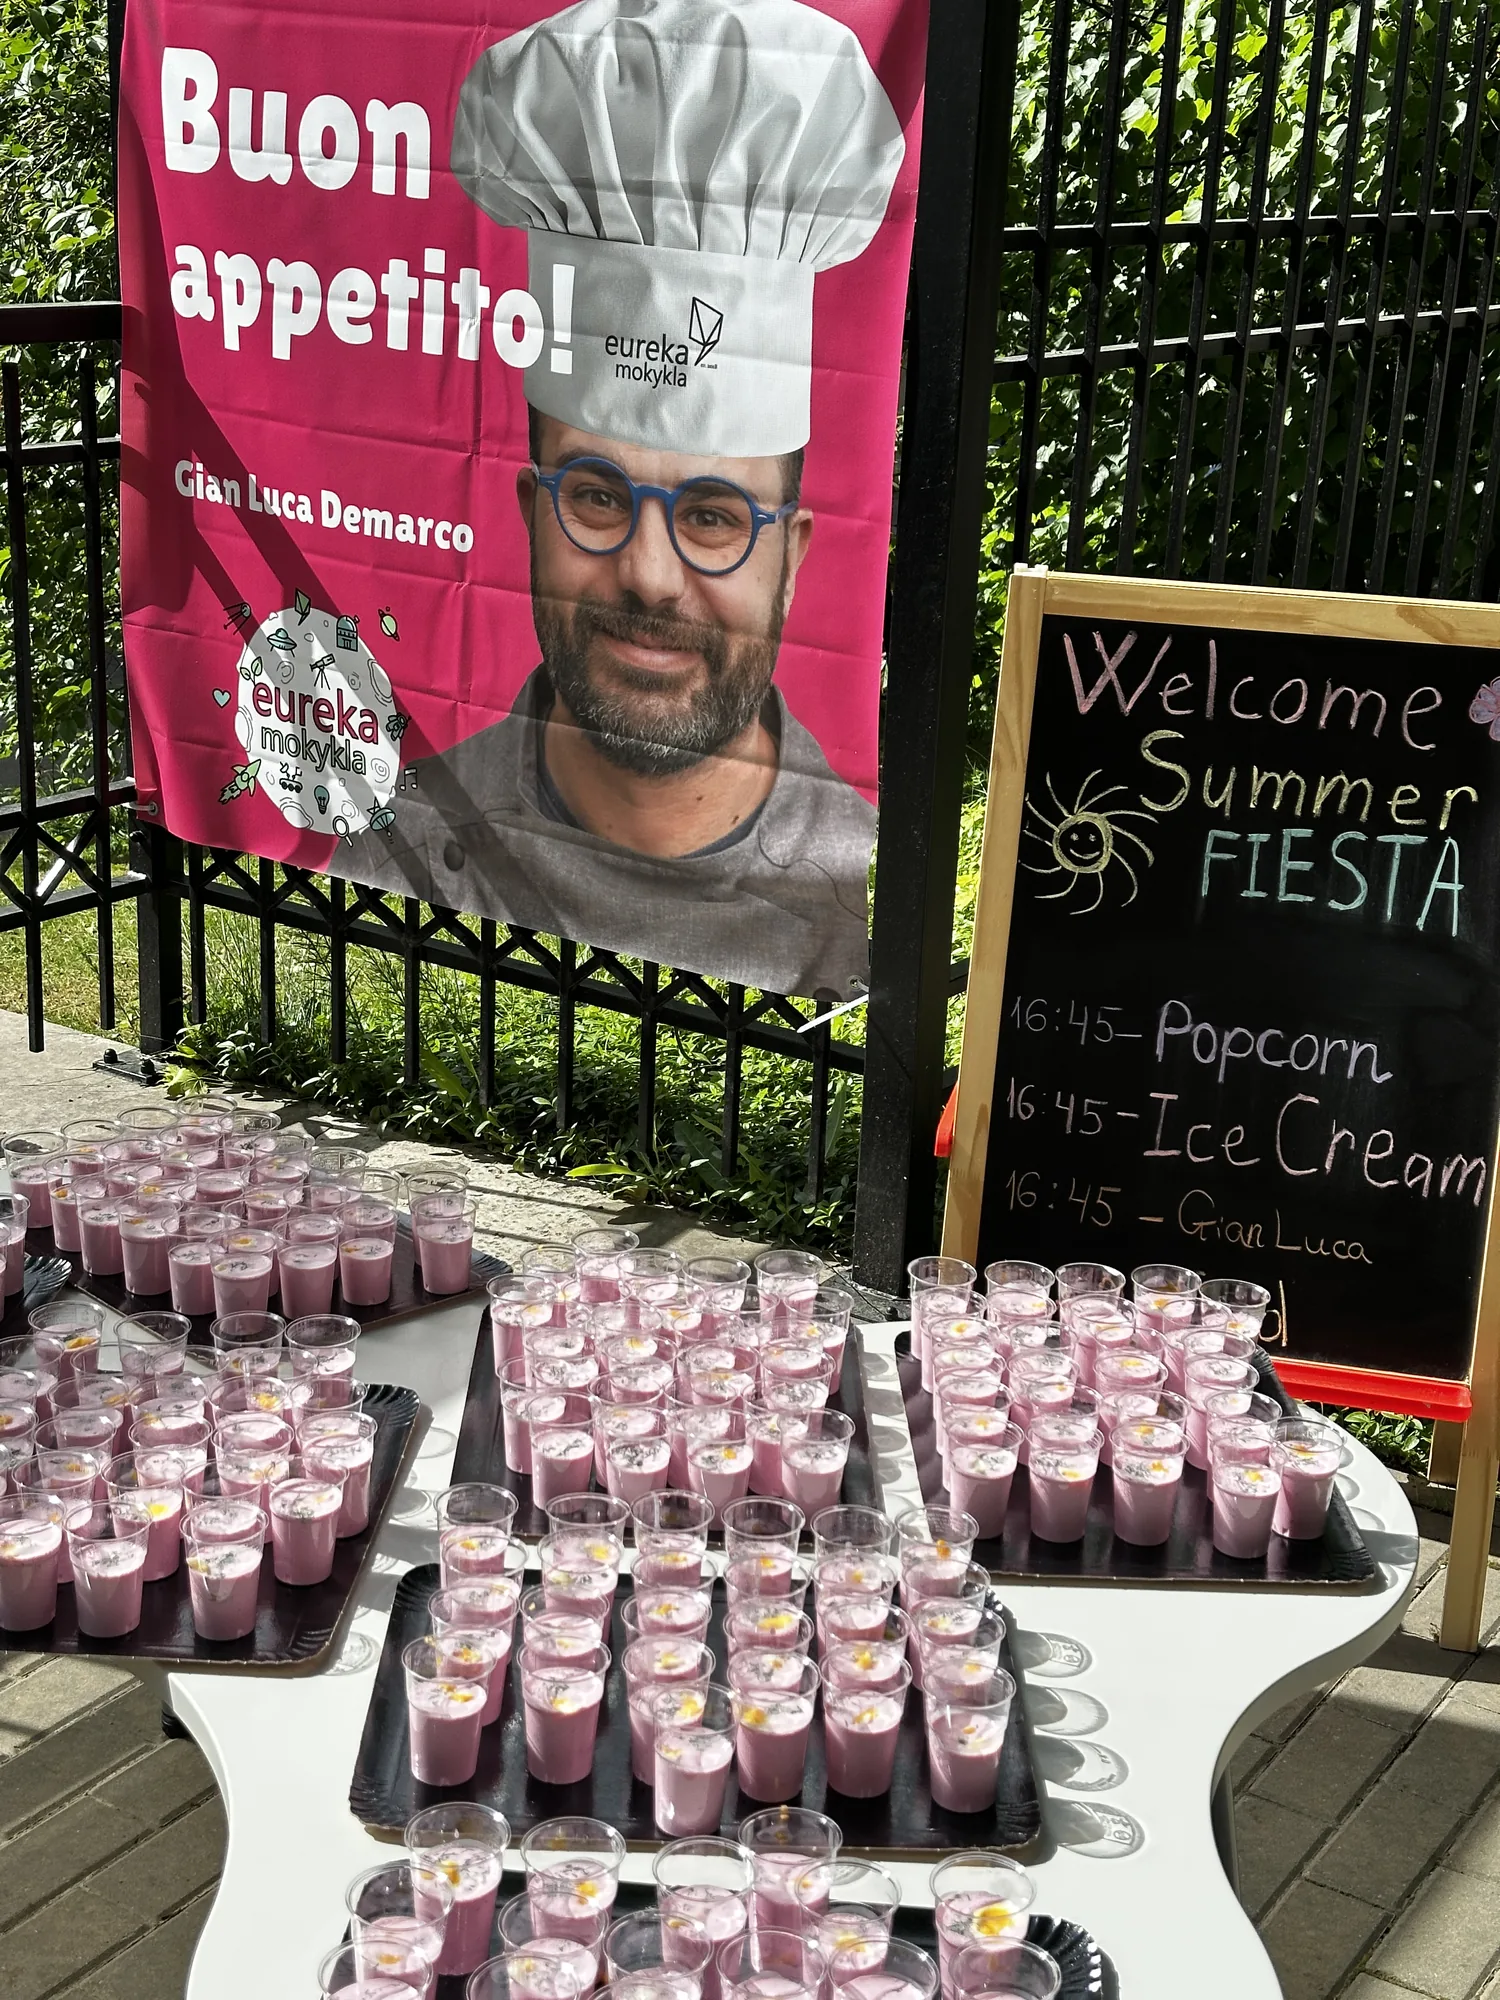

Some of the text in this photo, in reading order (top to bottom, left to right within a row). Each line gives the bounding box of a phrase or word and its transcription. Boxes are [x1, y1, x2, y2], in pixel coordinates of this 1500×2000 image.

[161, 47, 431, 199] Buon
[171, 244, 576, 375] appetito!
[605, 334, 689, 365] eureka
[615, 362, 687, 389] mokykla
[175, 459, 474, 553] Gian Luca Demarco
[252, 682, 379, 745] eureka
[1063, 631, 1444, 750] Welcome
[261, 726, 367, 775] mokykla
[1140, 730, 1479, 831] Summer
[1202, 829, 1465, 936] FIESTA
[1156, 1000, 1394, 1084] Popcorn
[1143, 1092, 1260, 1165] Ice
[1277, 1094, 1488, 1206] Cream
[1006, 1170, 1121, 1227] 16:45
